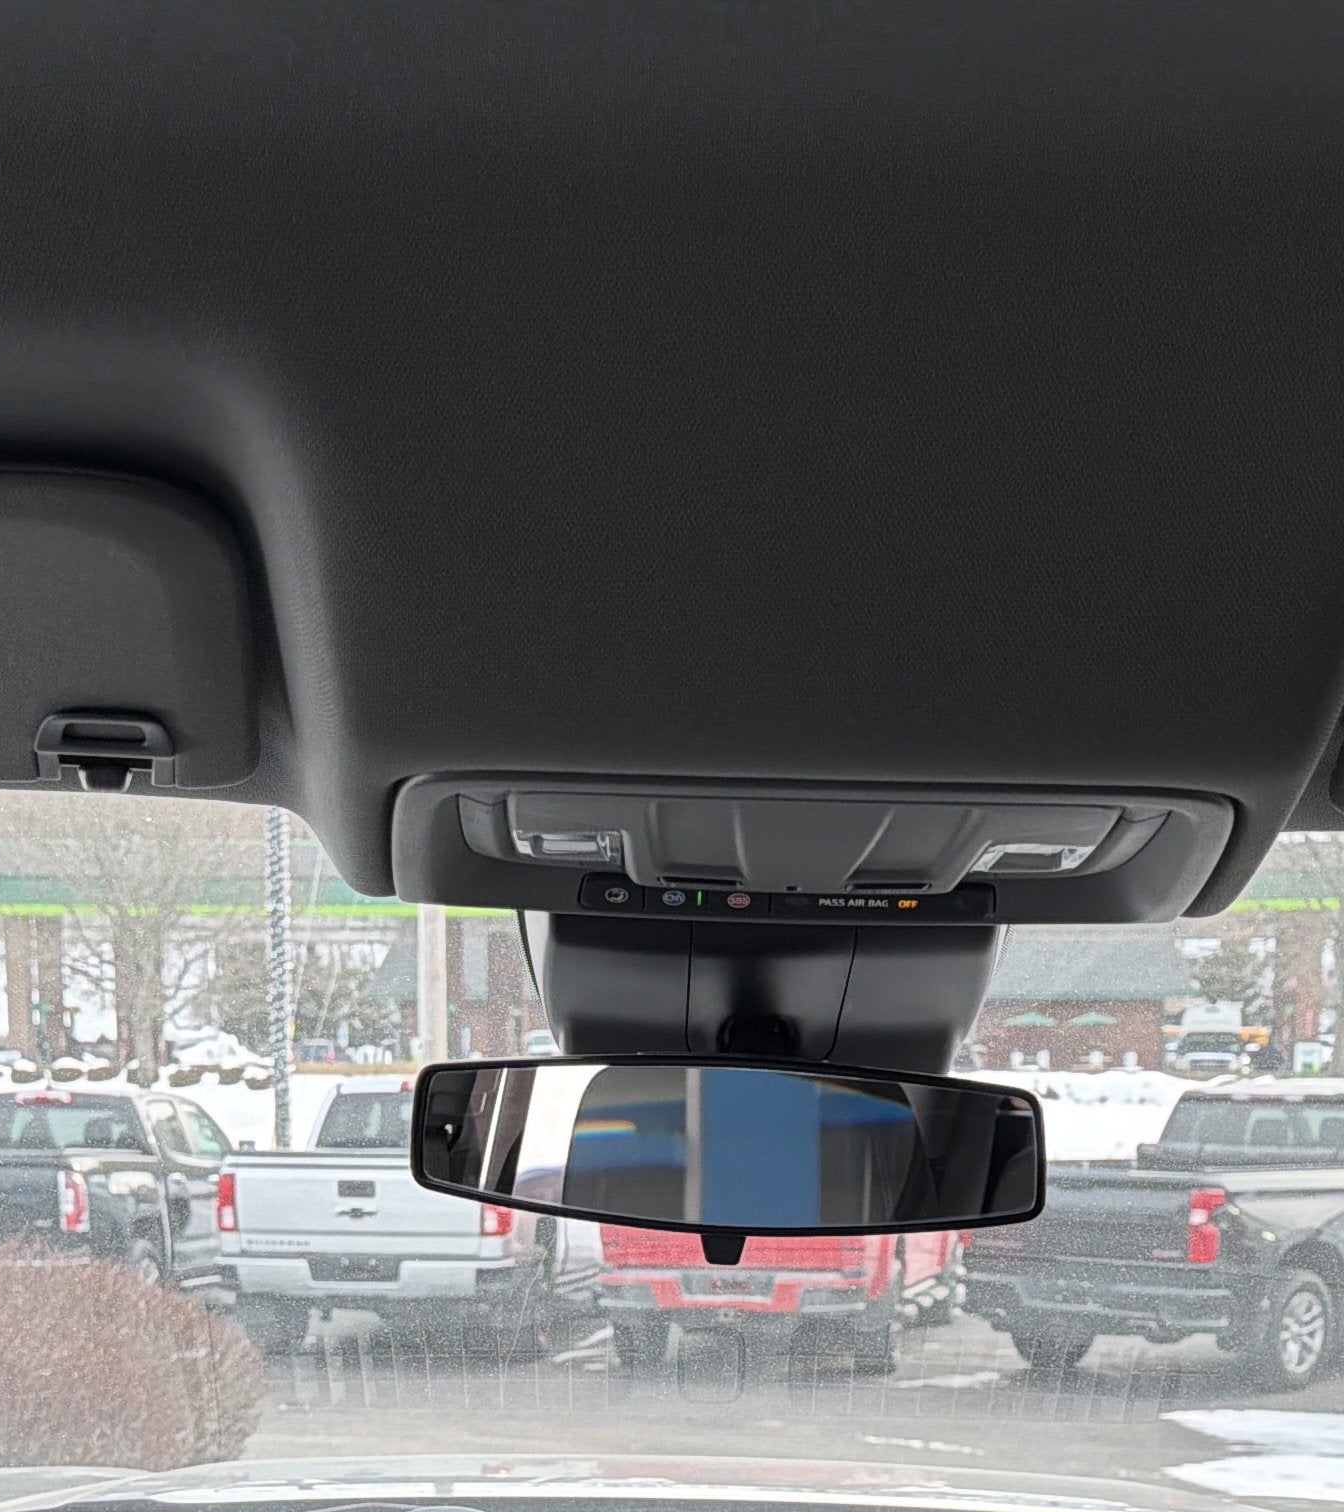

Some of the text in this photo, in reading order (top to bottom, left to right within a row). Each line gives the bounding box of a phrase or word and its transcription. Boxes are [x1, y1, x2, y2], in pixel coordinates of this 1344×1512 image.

[818, 897, 889, 909] PASS AIR BAG
[897, 900, 919, 910] OFF
